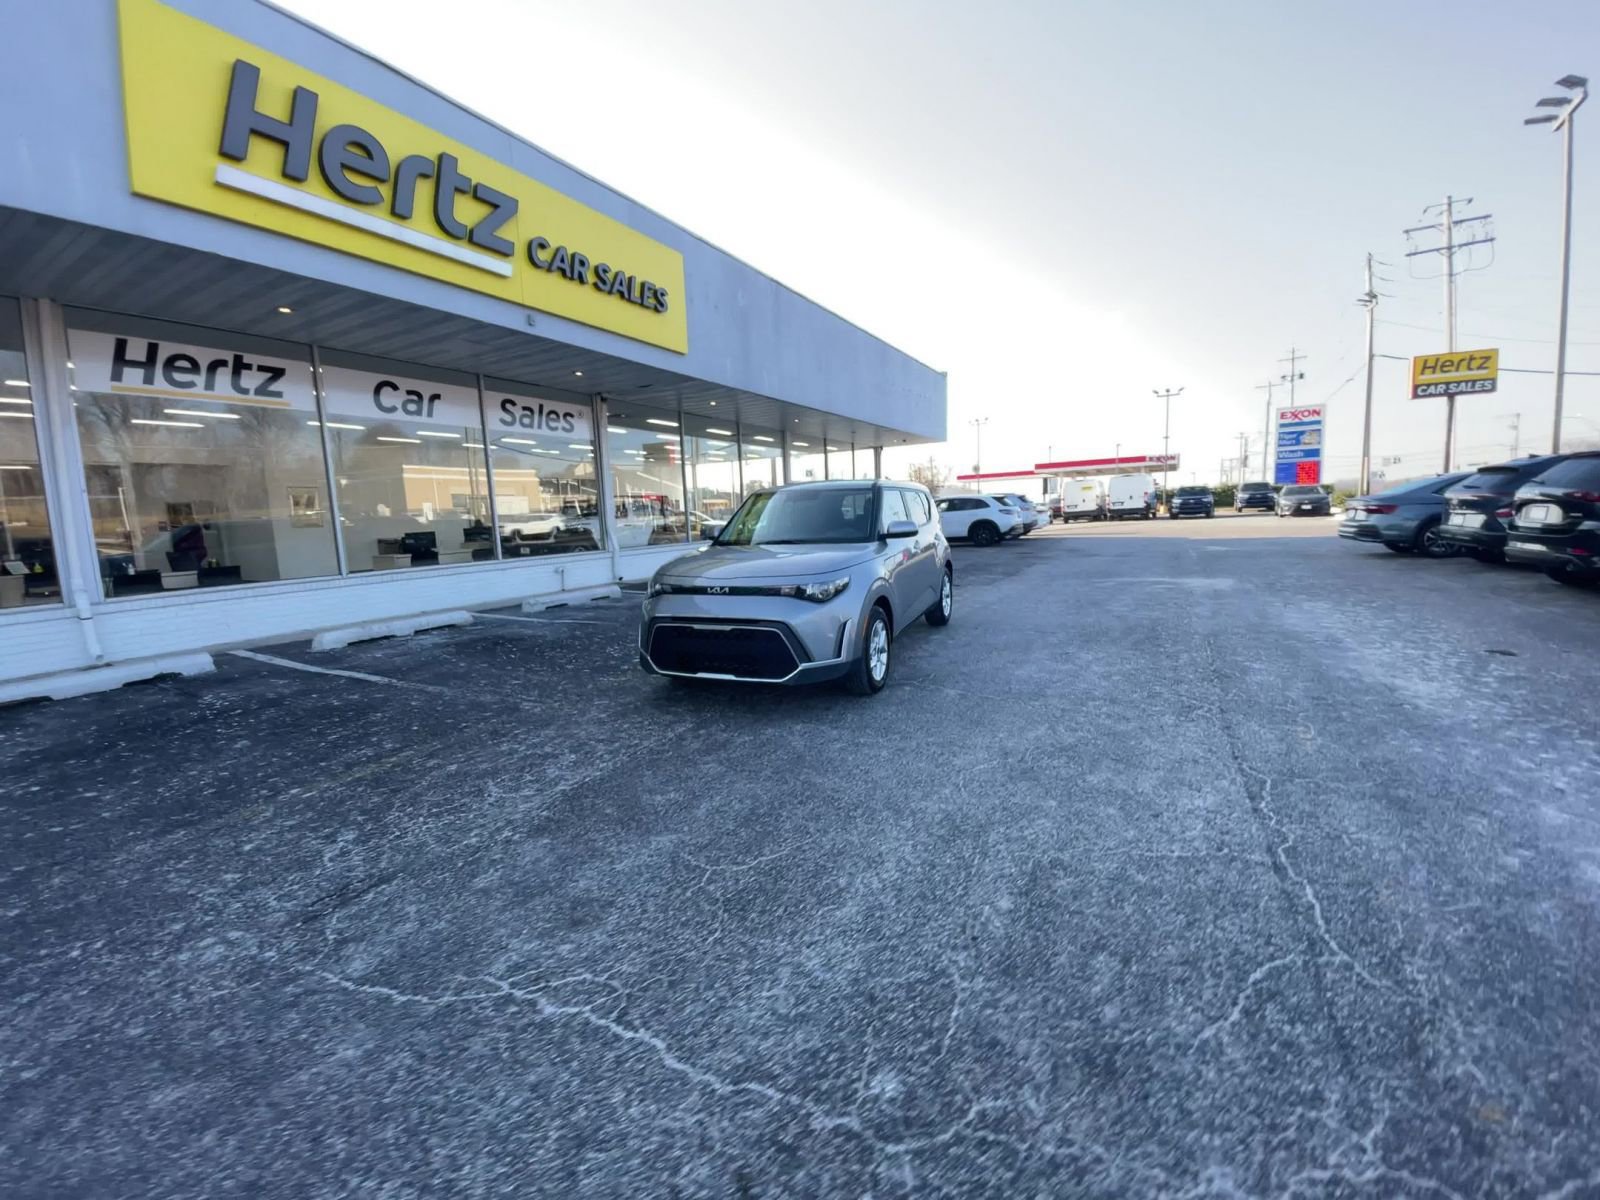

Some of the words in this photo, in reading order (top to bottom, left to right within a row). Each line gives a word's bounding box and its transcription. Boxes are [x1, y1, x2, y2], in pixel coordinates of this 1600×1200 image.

[219, 59, 518, 256] Hertz
[527, 236, 591, 285] CAR
[593, 262, 669, 313] SALES
[1420, 354, 1493, 376] Hertz
[110, 337, 287, 398] Hertz
[373, 380, 442, 418] Car
[1417, 383, 1446, 395] CAR
[1447, 379, 1493, 393] SALES
[1280, 408, 1321, 421] EXXON
[1278, 450, 1304, 458] Wash
